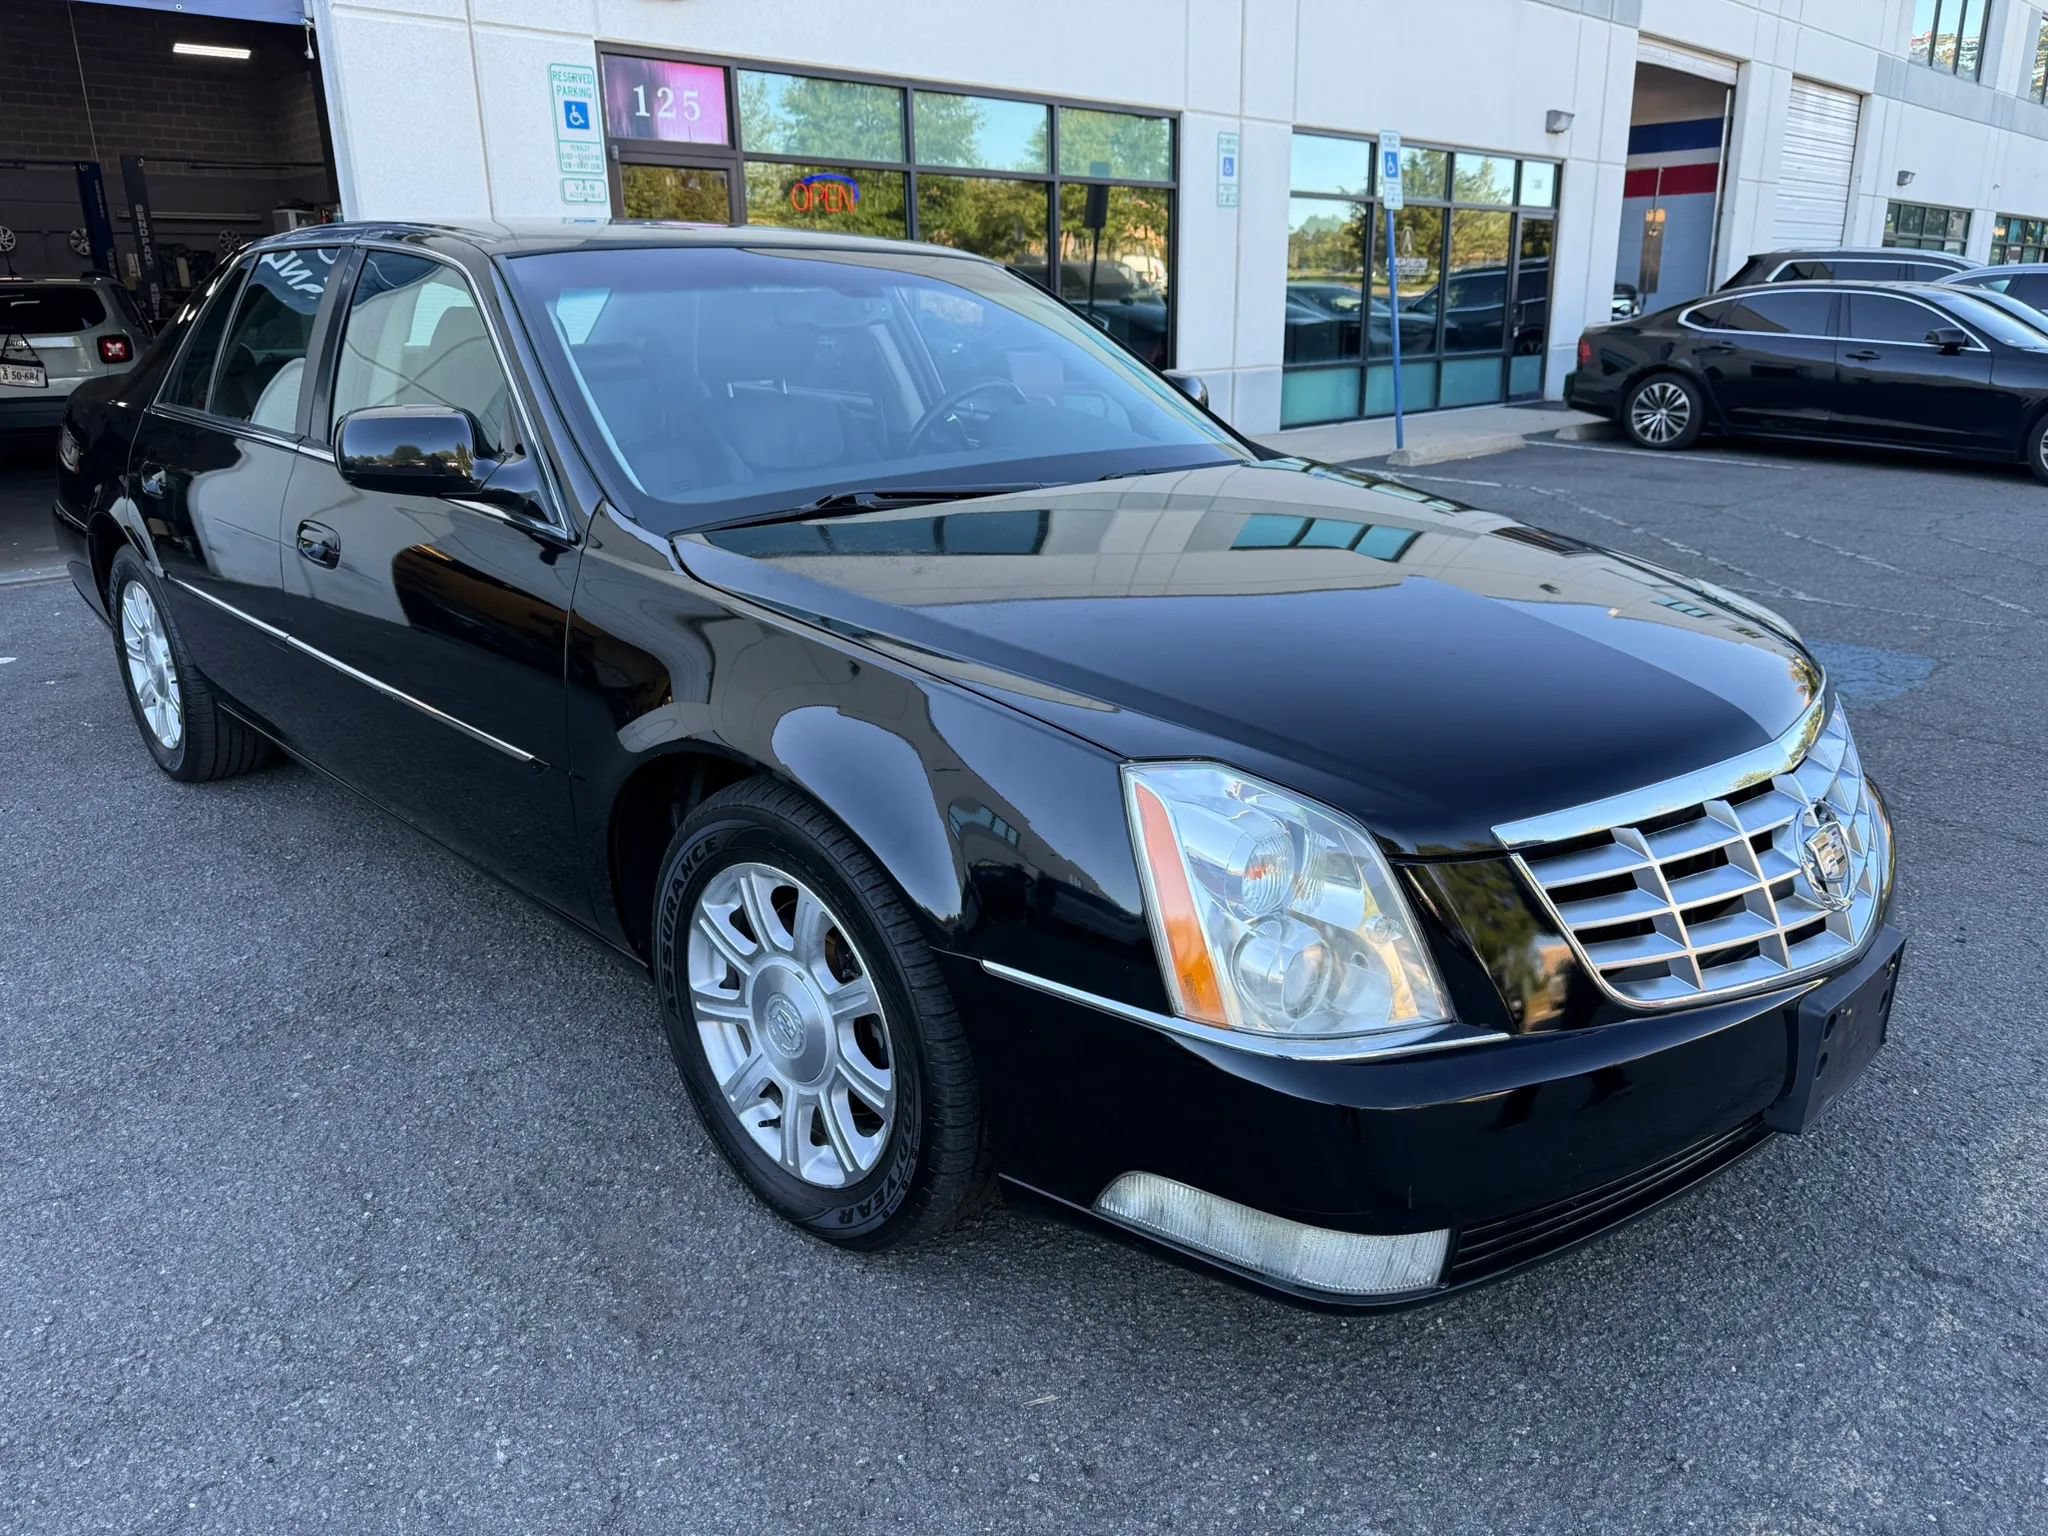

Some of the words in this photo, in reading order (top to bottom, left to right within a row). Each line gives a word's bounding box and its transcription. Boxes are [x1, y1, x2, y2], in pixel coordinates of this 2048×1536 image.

[552, 70, 593, 84] RESERVED
[556, 85, 592, 98] PARKING
[633, 84, 701, 121] 125
[575, 183, 596, 192] VAN
[791, 182, 855, 215] OPEN
[660, 835, 719, 1021] ASSURANCE
